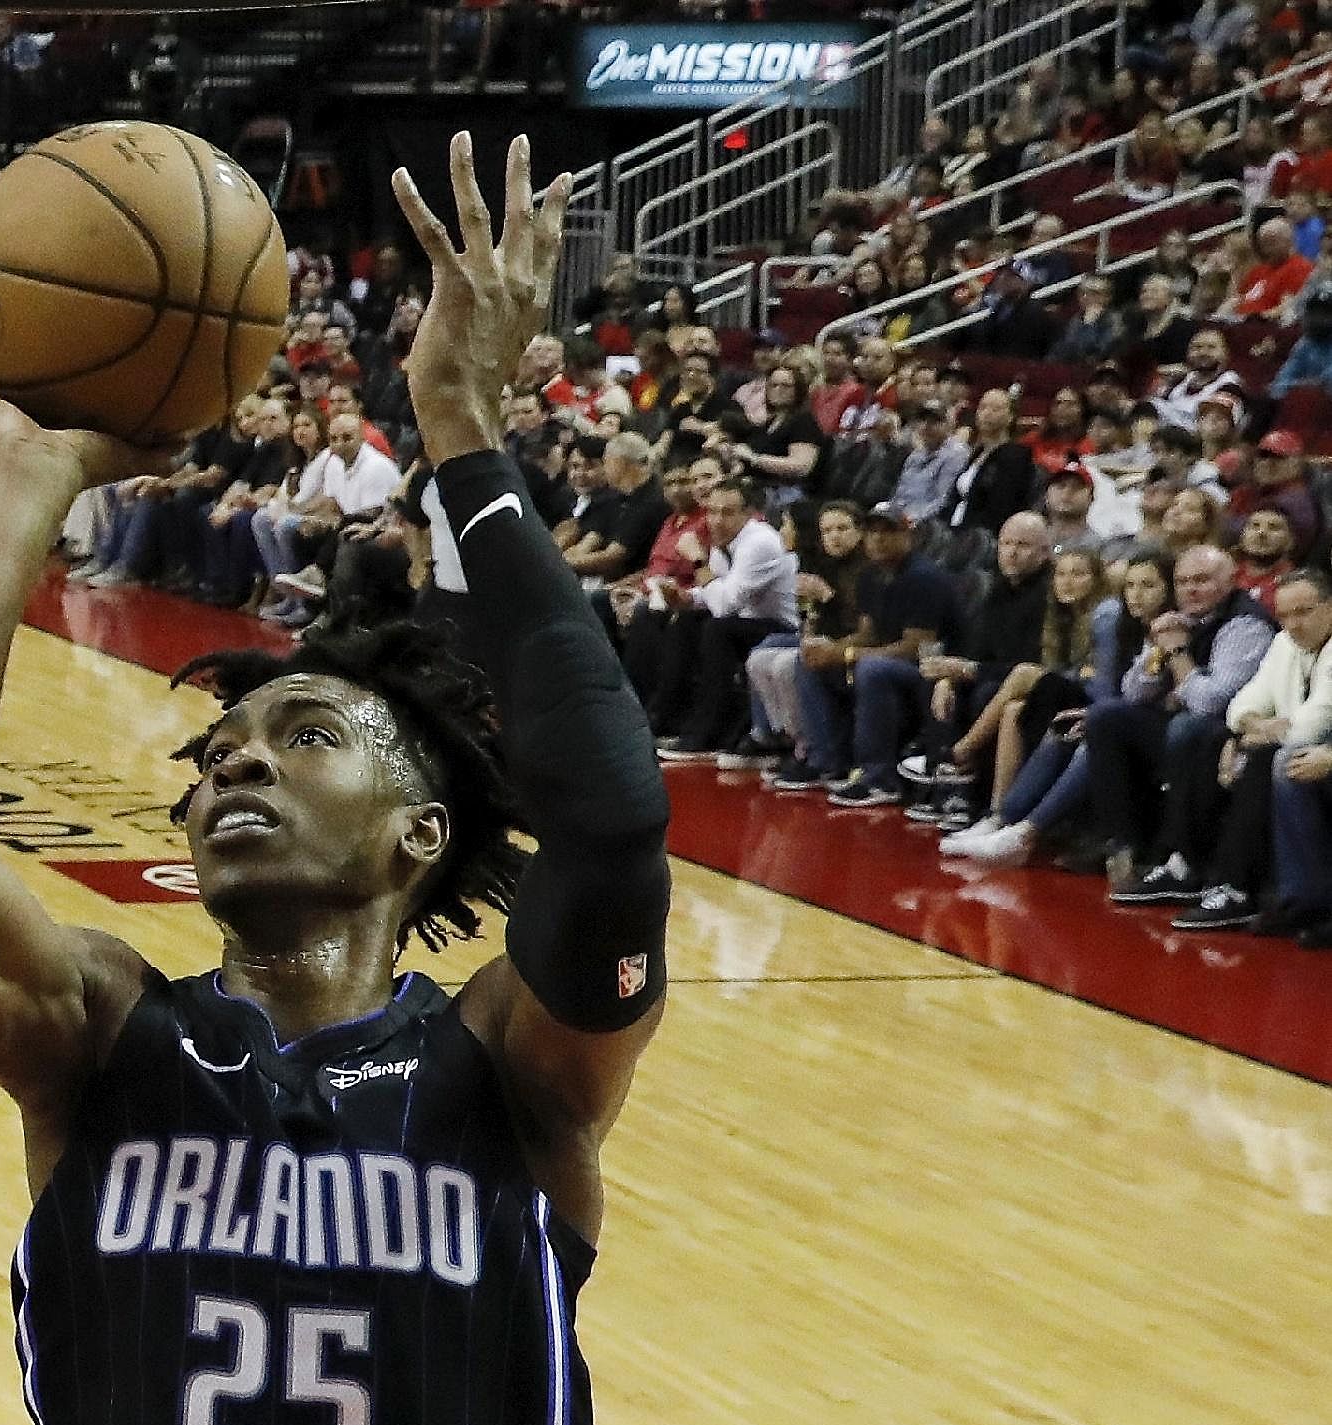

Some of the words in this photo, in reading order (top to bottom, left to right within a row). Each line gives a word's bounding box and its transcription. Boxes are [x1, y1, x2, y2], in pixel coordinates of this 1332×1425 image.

[645, 42, 822, 81] MISSION
[325, 1058, 419, 1090] Disney
[95, 1137, 482, 1288] ORLANDO
